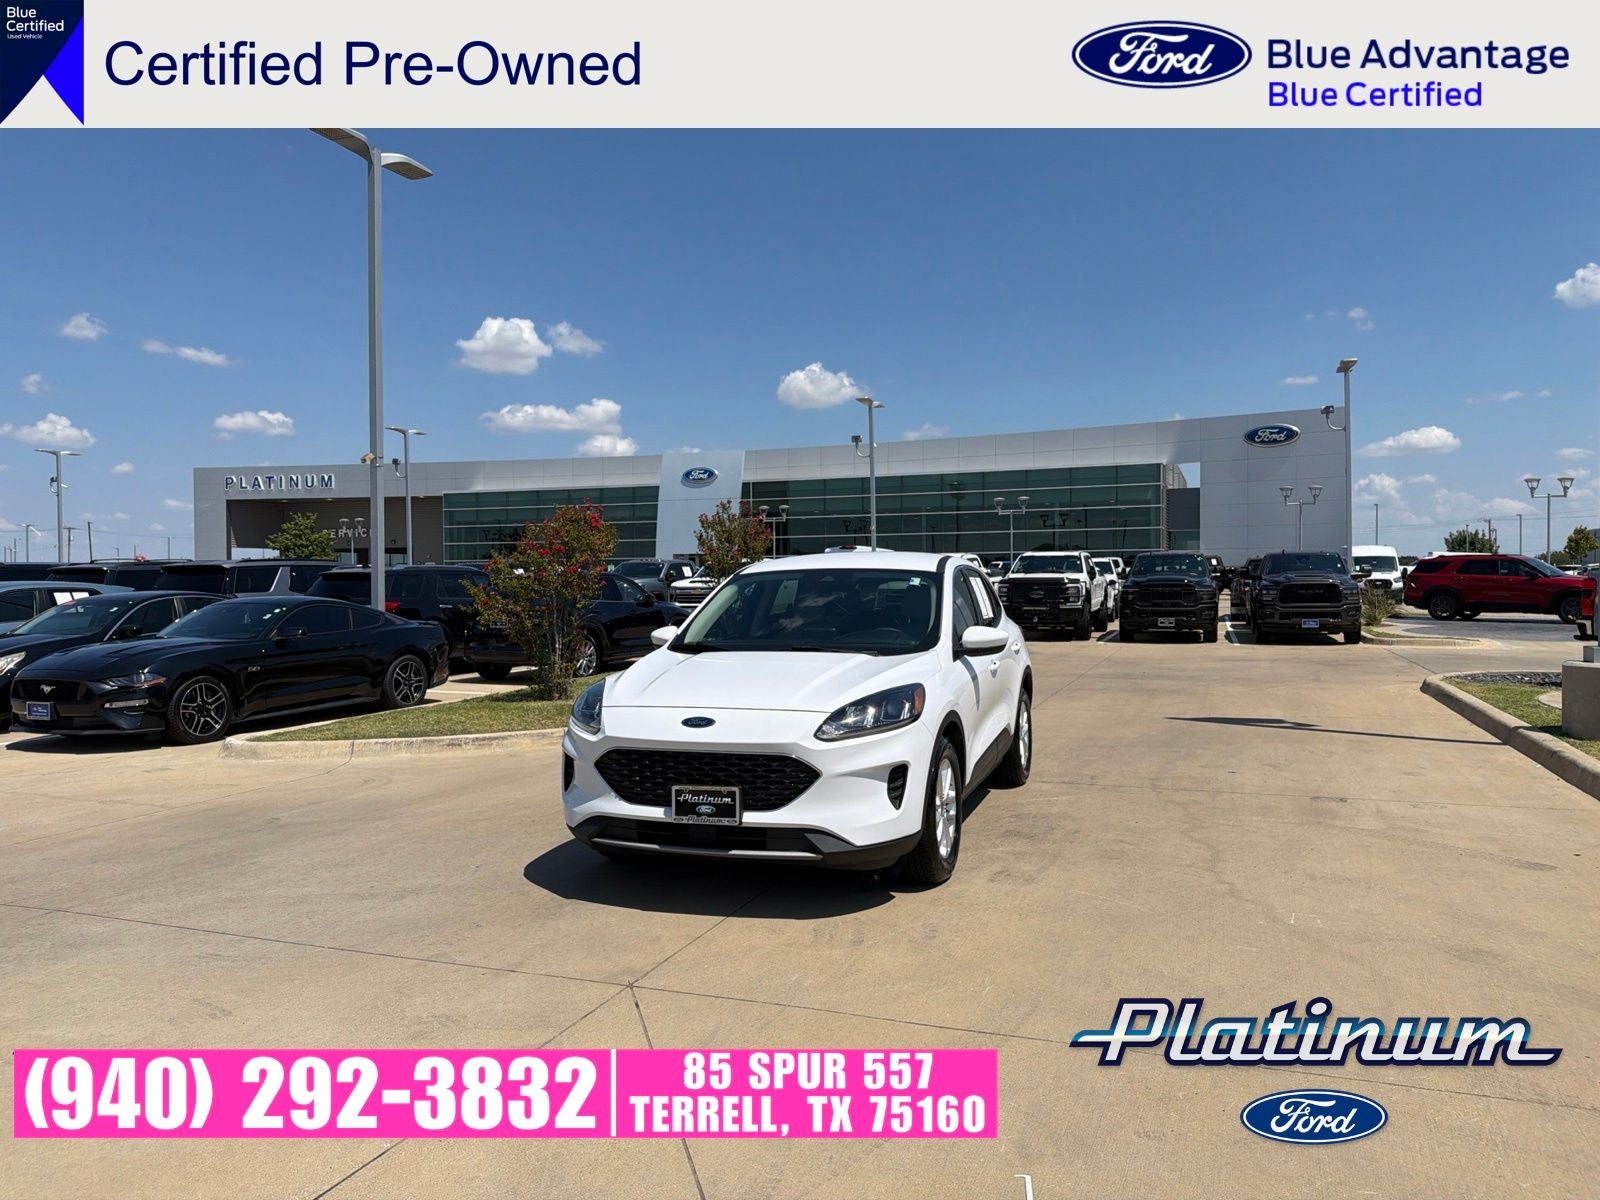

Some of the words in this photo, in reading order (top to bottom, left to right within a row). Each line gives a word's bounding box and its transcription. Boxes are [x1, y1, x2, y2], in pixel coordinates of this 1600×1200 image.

[225, 474, 335, 490] PLATINUM
[322, 527, 372, 538] ERVIC
[677, 793, 735, 805] Platinum
